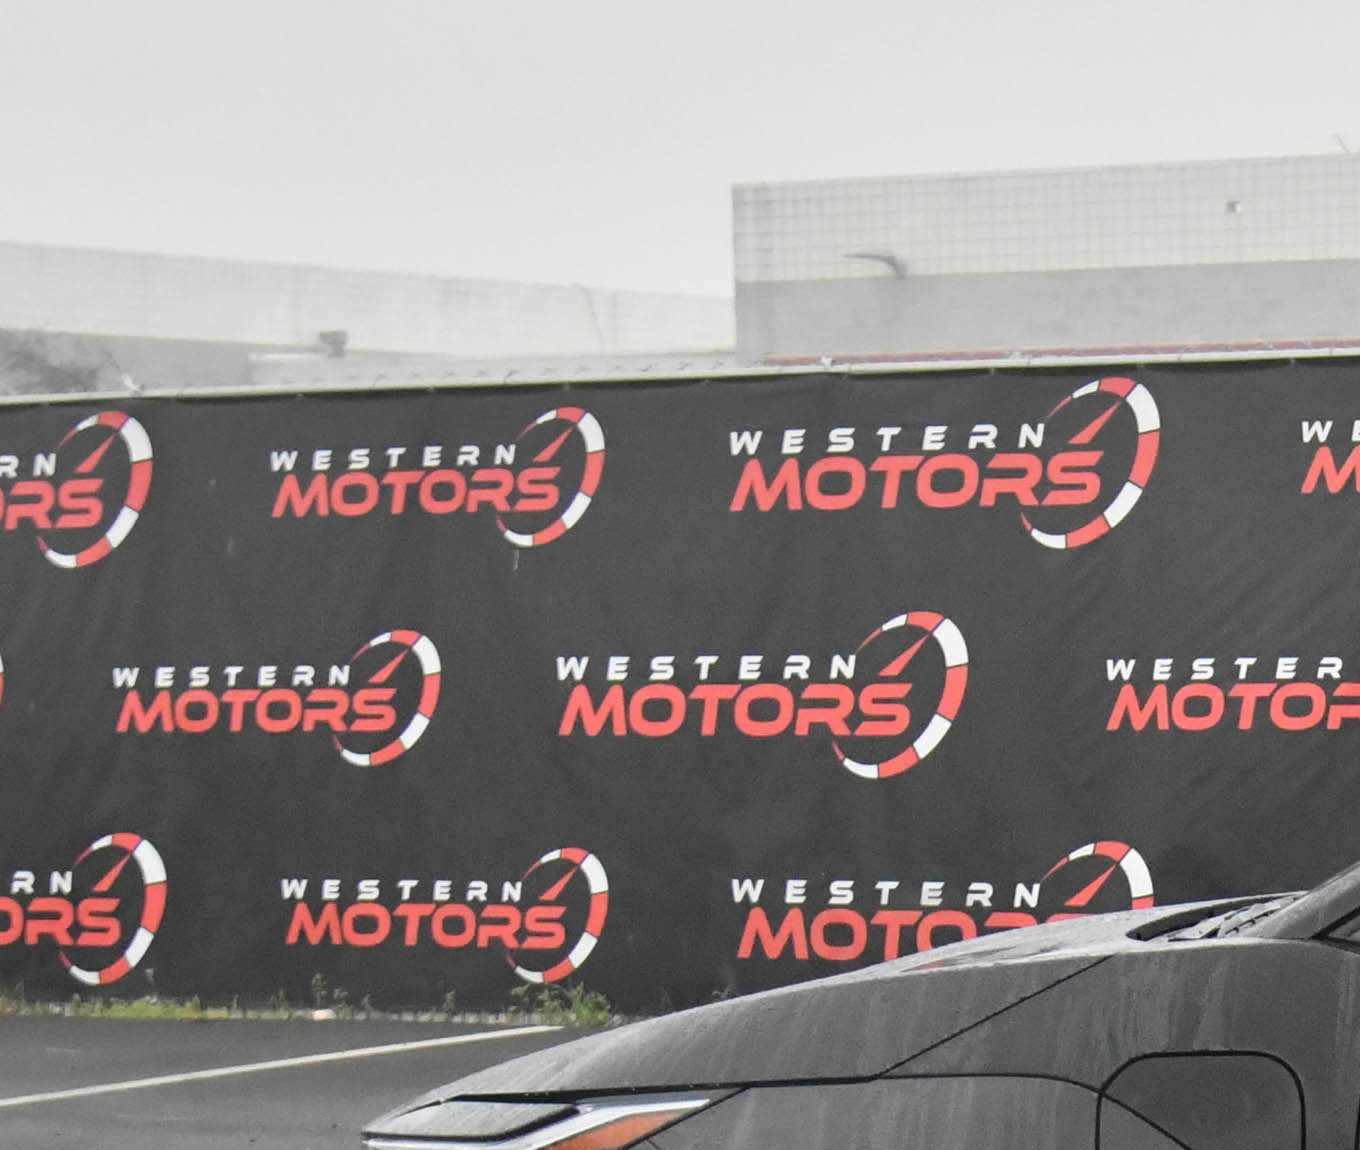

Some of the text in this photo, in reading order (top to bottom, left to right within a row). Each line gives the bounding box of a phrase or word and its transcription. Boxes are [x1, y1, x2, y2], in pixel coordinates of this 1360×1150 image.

[270, 443, 517, 472] WESTERN
[729, 422, 1046, 456] WESTERN
[272, 466, 561, 518] MOTORS
[730, 450, 1105, 513] MOTORS
[112, 664, 351, 688] WESTERN
[556, 654, 857, 681] WESTERN
[116, 687, 397, 734] MOTORS
[559, 682, 913, 738] MOTORS
[281, 878, 523, 903] WESTERN
[731, 878, 1041, 908] WESTERN
[286, 901, 567, 950] MOTORS
[737, 903, 1086, 961] MOTO
